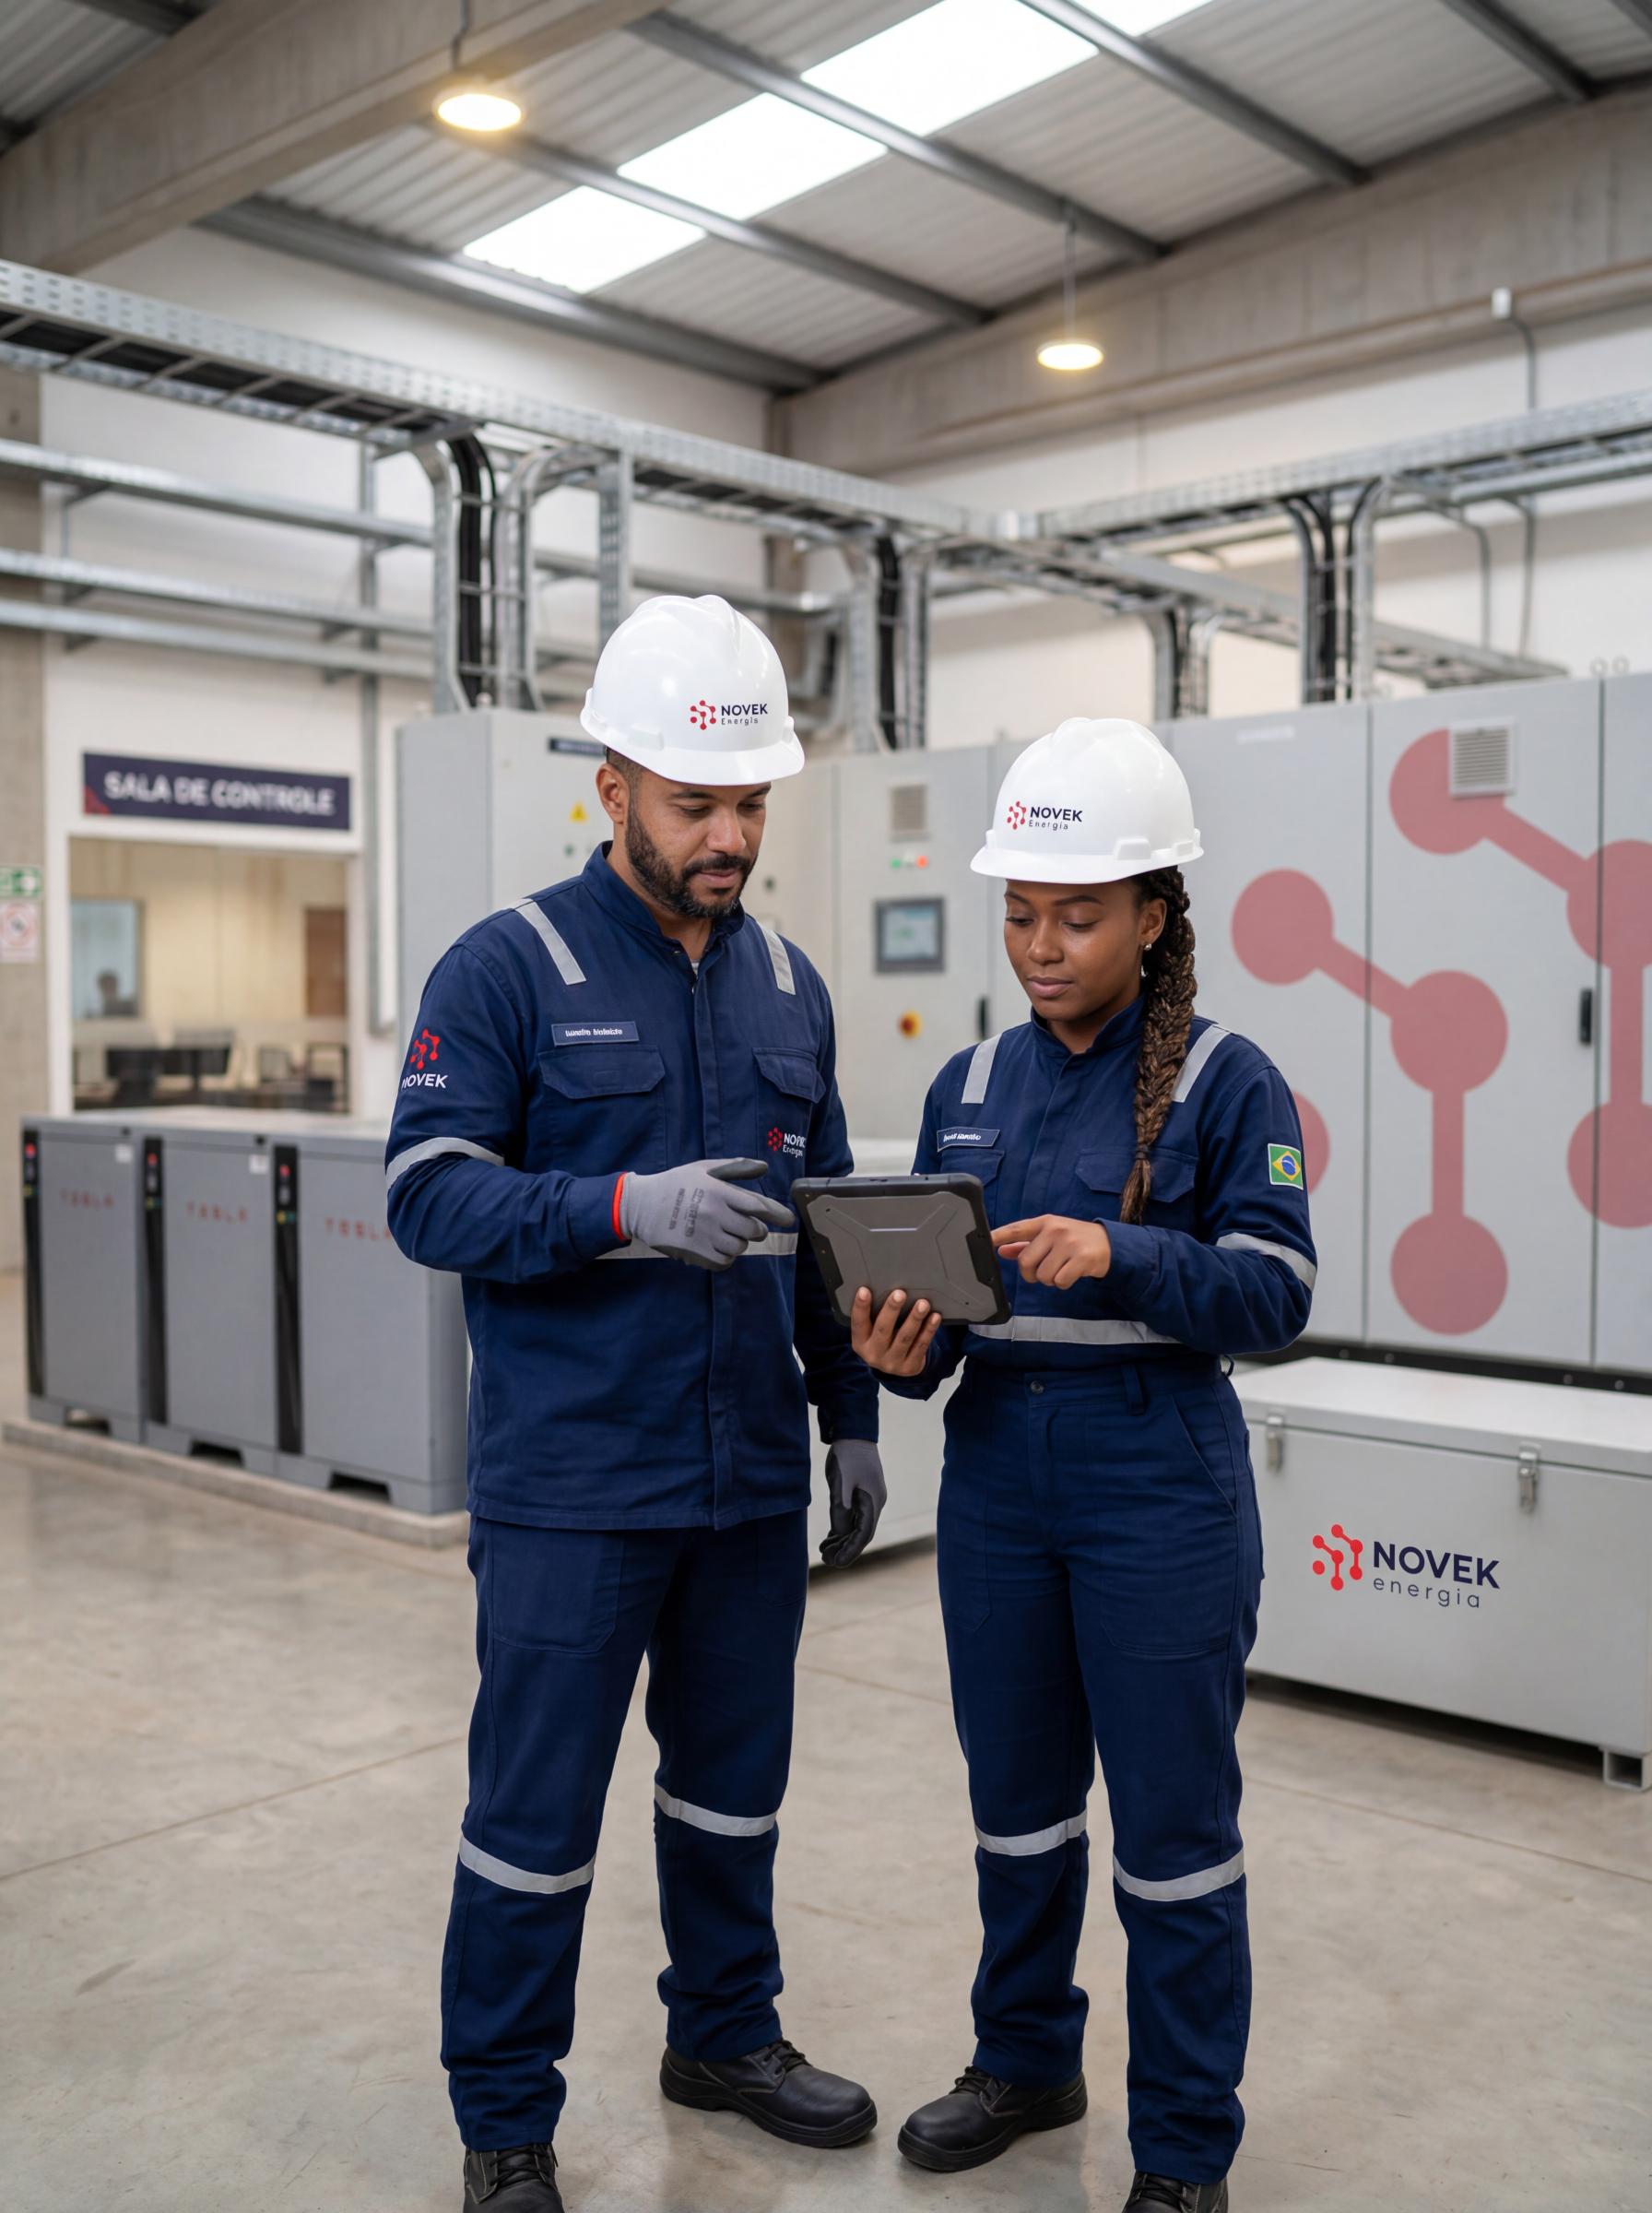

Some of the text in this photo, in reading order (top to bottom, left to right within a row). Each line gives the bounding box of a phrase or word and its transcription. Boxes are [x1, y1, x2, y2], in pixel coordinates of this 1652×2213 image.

[721, 704, 768, 716] NOVEK
[103, 770, 336, 816] SALA DE CONTROLE
[1030, 806, 1083, 822] NOVEK
[1373, 1541, 1501, 1589] NOVEK
[1373, 1578, 1481, 1608] energia
